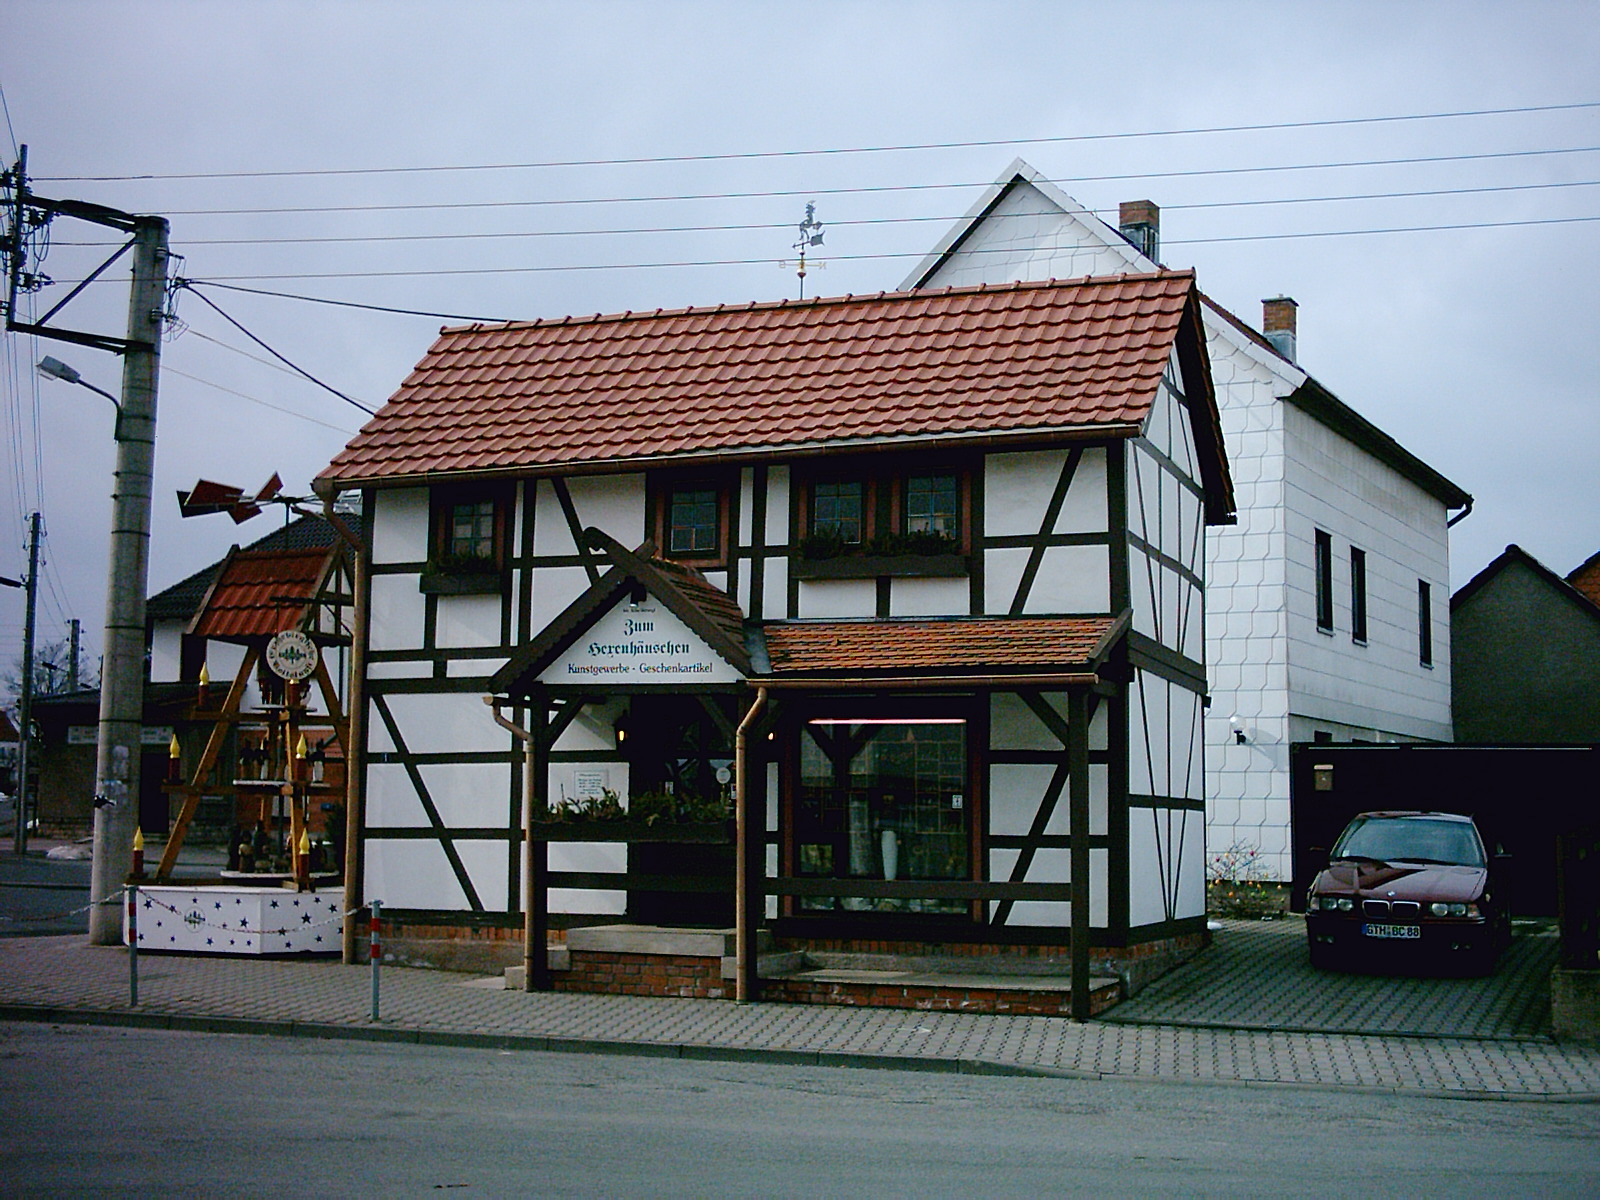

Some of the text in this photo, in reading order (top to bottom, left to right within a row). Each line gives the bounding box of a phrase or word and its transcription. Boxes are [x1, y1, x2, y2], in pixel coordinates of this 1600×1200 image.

[624, 619, 654, 636] Zum
[588, 640, 690, 657] Hexenhäuschen
[568, 663, 630, 675] Kunstgewerbe
[639, 662, 713, 674] Geschenkartikel
